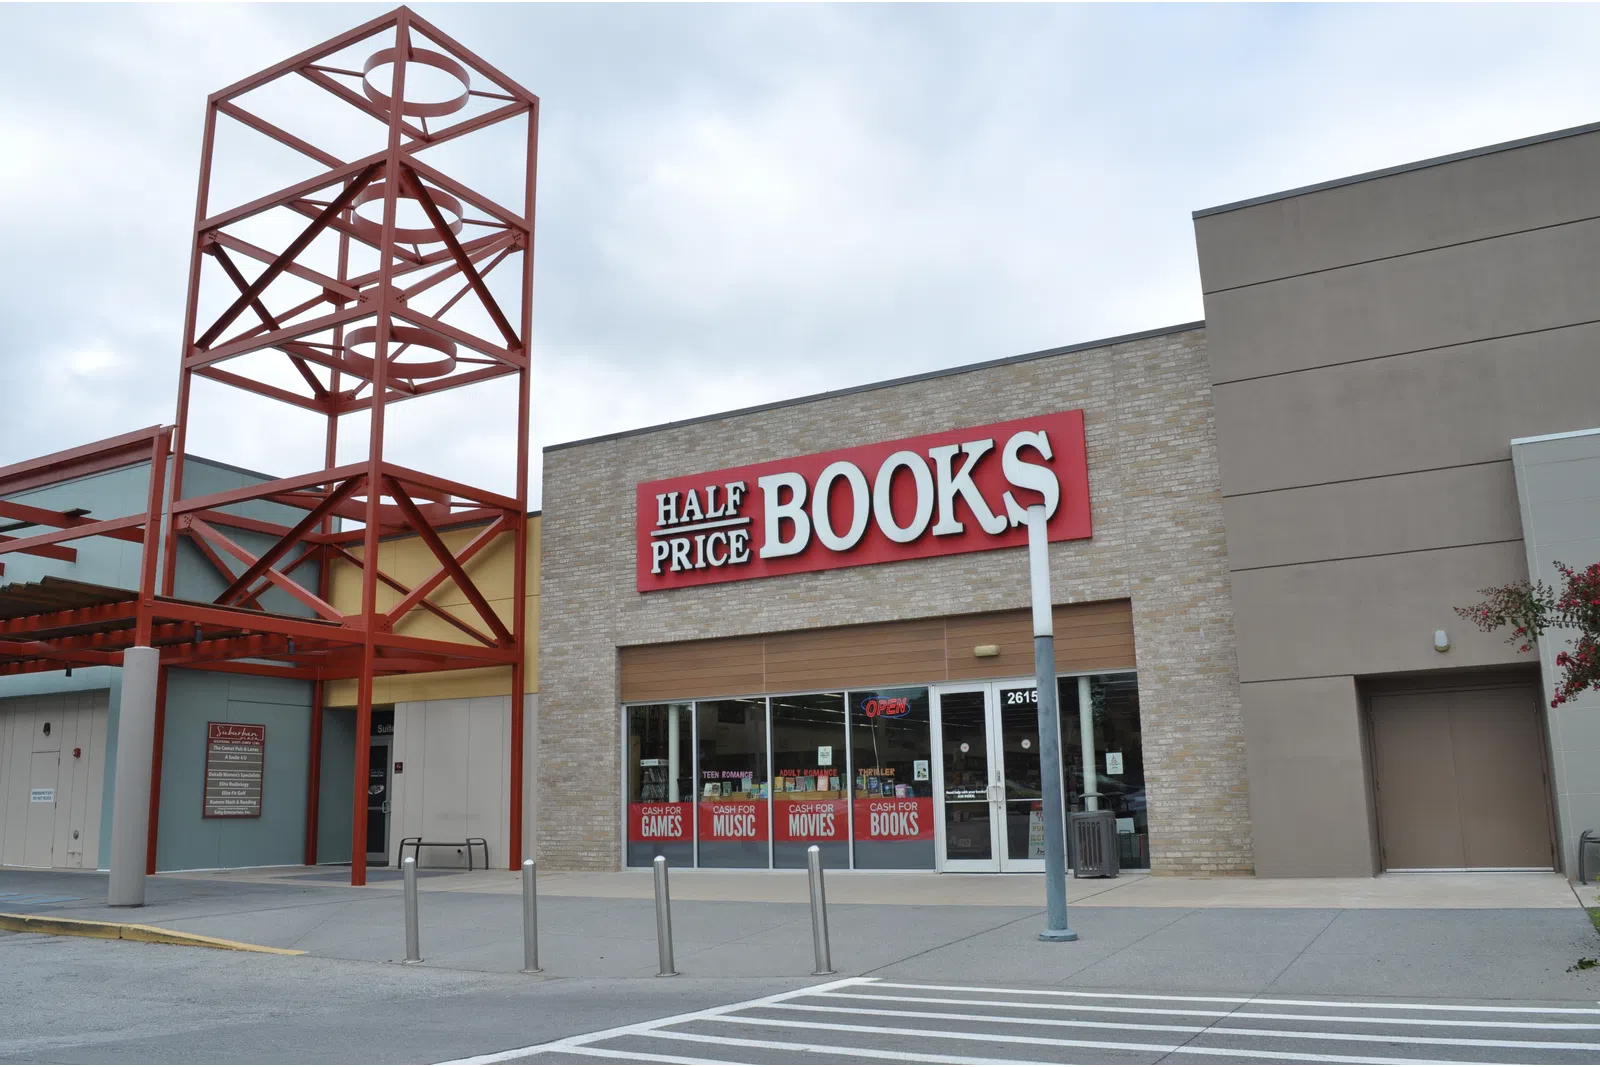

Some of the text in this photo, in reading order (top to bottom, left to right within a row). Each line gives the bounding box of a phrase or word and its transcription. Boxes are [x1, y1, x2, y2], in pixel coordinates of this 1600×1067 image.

[758, 430, 1060, 559] BOOKS
[656, 481, 748, 526] HALF
[650, 529, 750, 574] PRICE
[1007, 690, 1038, 704] 2615
[865, 697, 907, 718] OPEN
[216, 726, 258, 737] Suburban
[703, 771, 753, 779] TEEN ROMANCE
[779, 768, 837, 777] ADULT ROMANCE
[858, 767, 896, 776] THRILLER
[642, 806, 682, 815] CASH FOR
[713, 805, 756, 814] CASH FOR
[788, 803, 834, 813] CASH FOR
[870, 801, 918, 812] CASH FOR
[641, 815, 683, 837] GAMES
[713, 814, 756, 837] MUSIC
[788, 813, 835, 837] MOVIES
[870, 811, 919, 836] BOOKS
